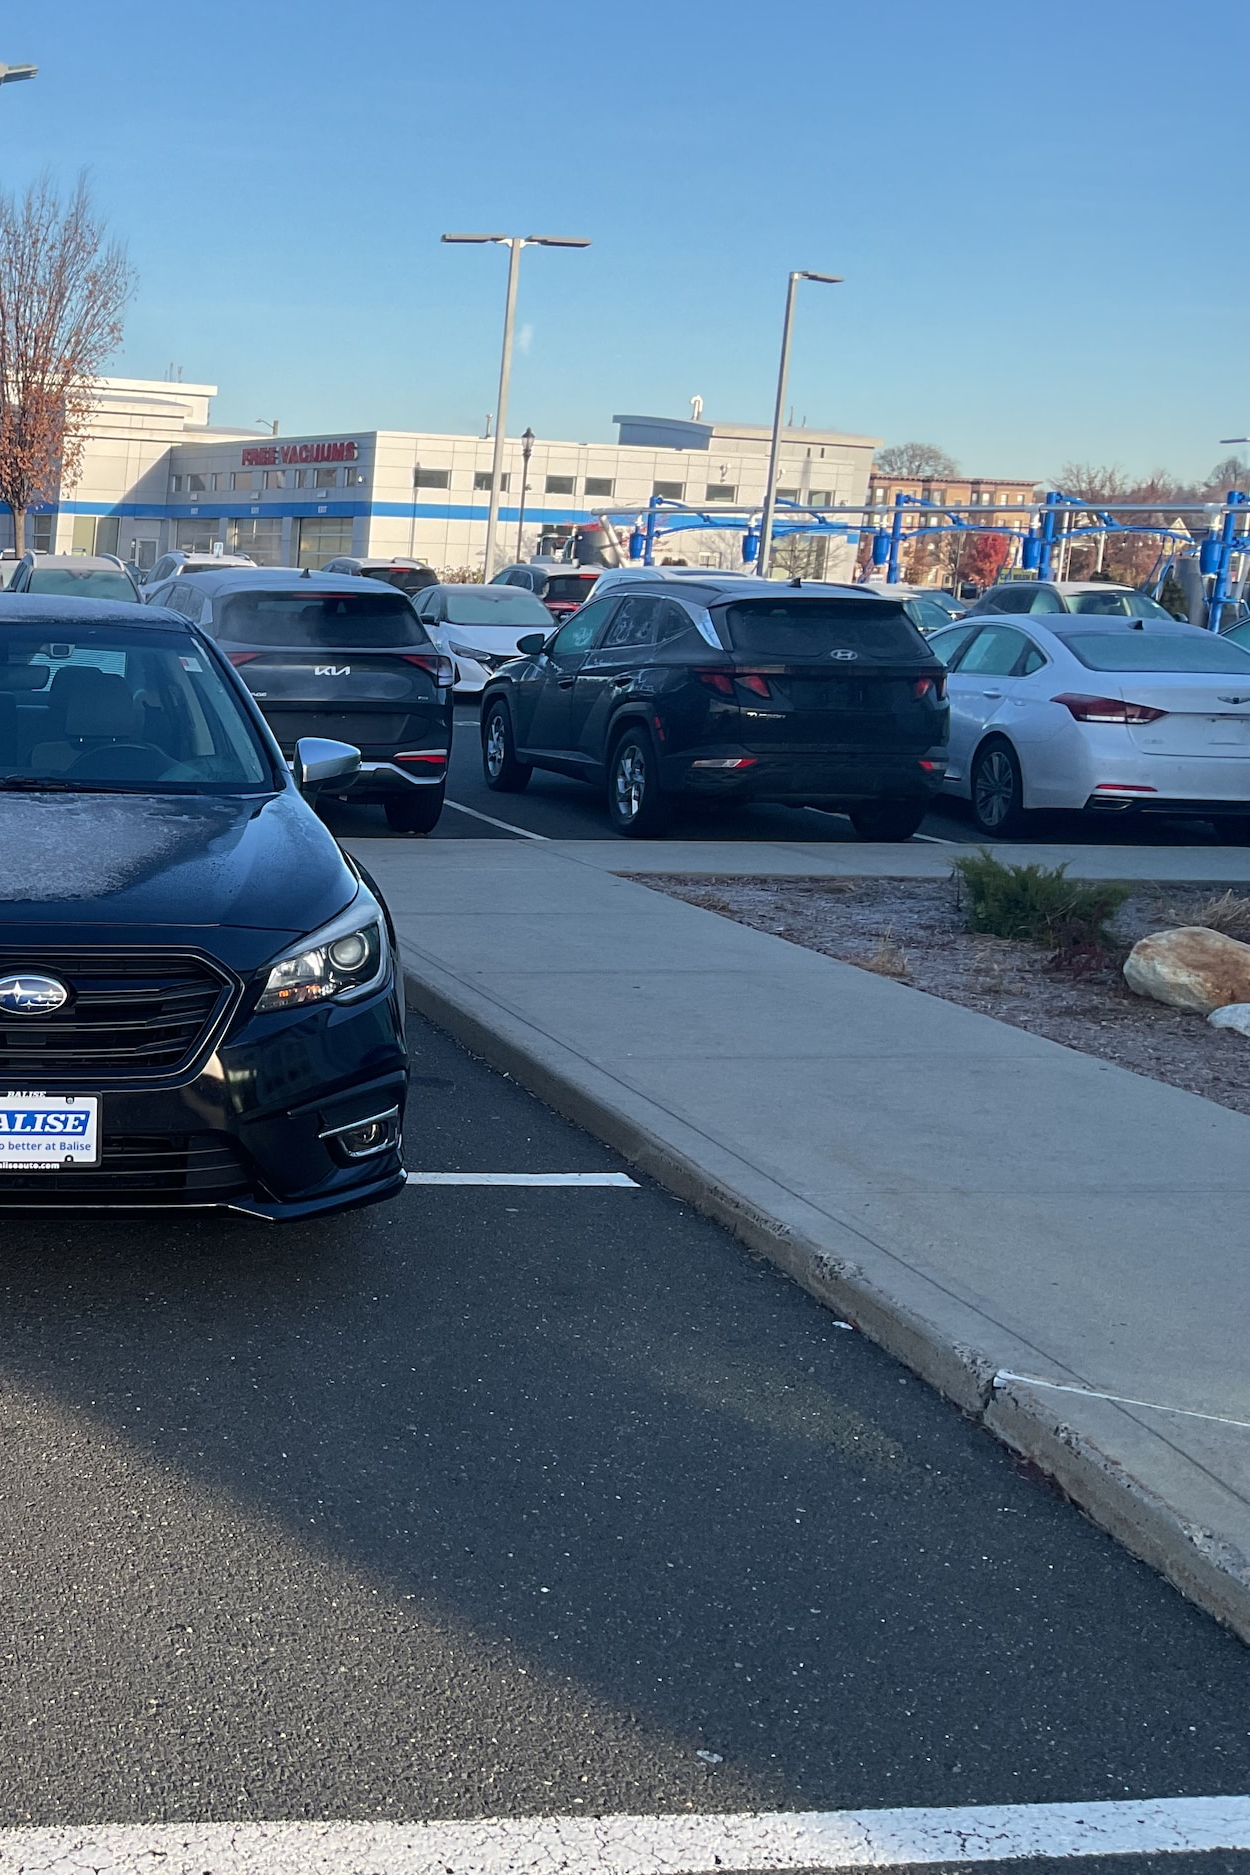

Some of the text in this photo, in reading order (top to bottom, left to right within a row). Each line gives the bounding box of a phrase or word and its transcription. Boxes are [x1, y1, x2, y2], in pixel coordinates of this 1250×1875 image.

[241, 441, 358, 466] FREE VACUUMS
[314, 665, 351, 676] KIA
[8, 1141, 42, 1151] better
[45, 1142, 56, 1151] at
[59, 1141, 92, 1151] Balise
